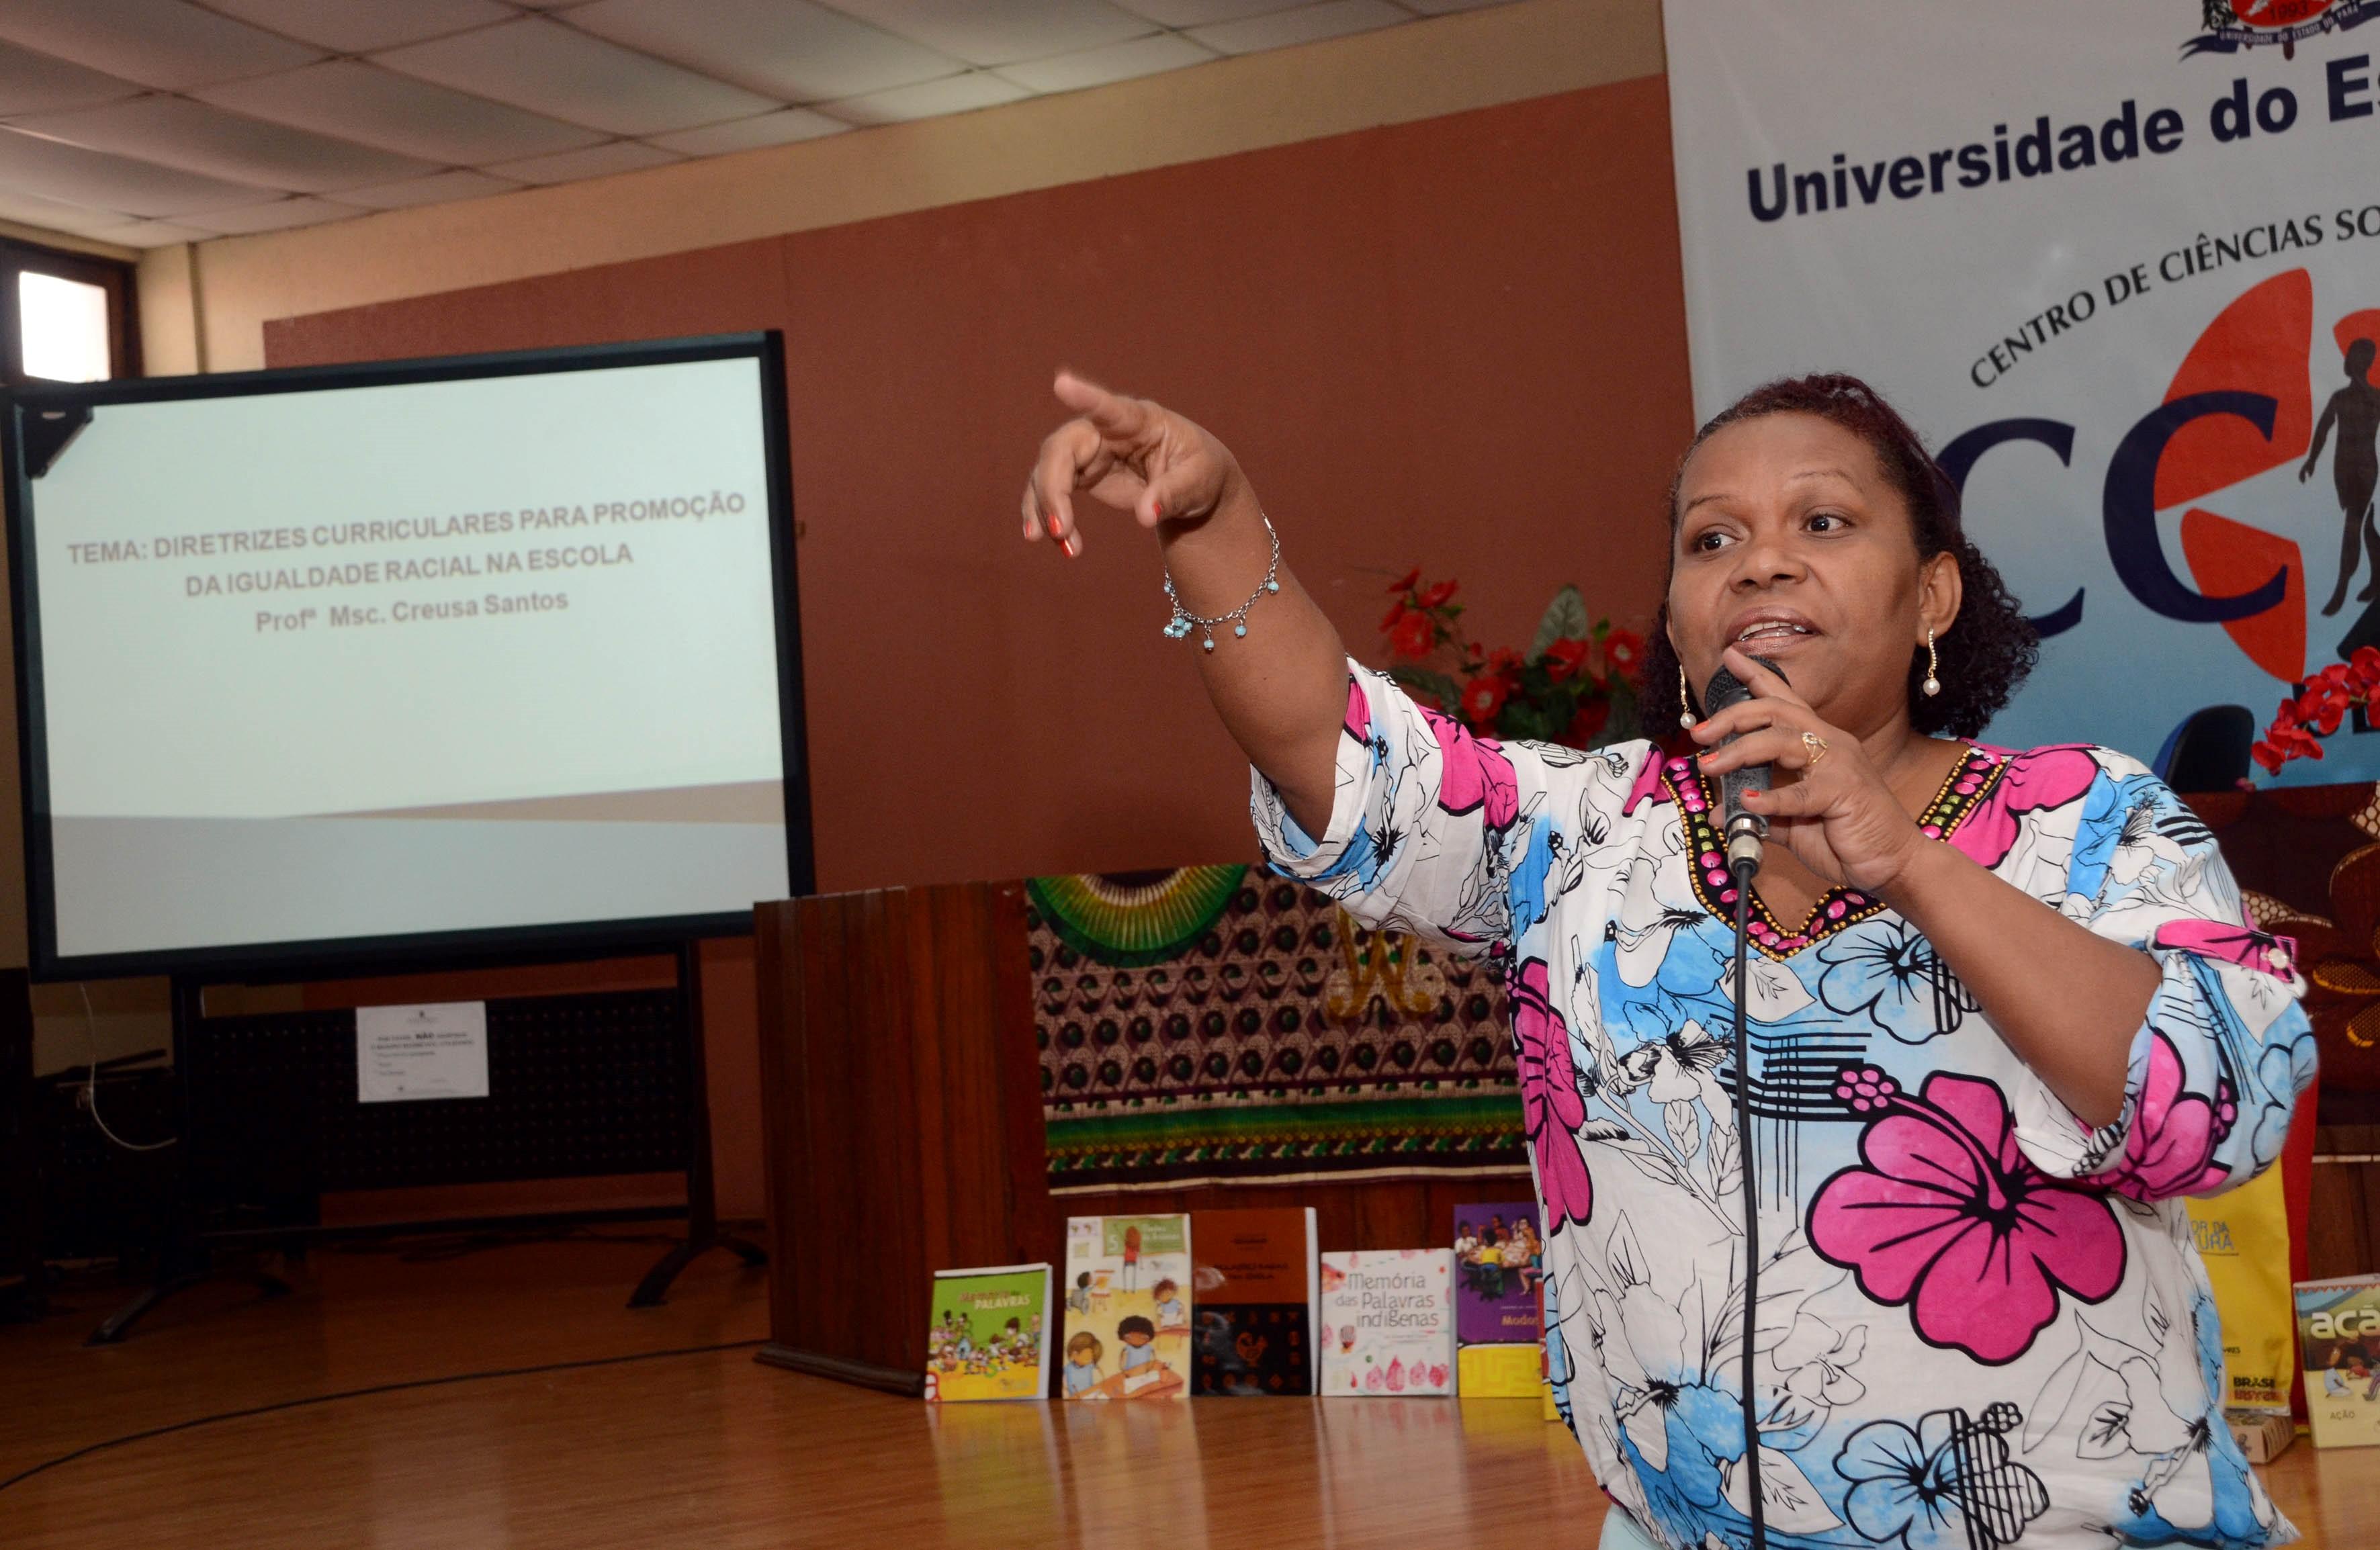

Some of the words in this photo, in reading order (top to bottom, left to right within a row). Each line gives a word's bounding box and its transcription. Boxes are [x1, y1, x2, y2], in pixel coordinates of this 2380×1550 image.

[2269, 1, 2308, 21] 1993
[1746, 99, 2185, 223] Universidade
[2209, 78, 2298, 142] do
[2325, 54, 2380, 123] E
[1970, 289, 2096, 390] CENTRO
[2103, 263, 2151, 306] DE
[2158, 214, 2324, 283] CIÊNCIAS
[2335, 205, 2380, 242] SO
[67, 540, 147, 565] TEMA:
[154, 527, 308, 559] DIRETRIZES
[312, 510, 515, 547] CURRICULARES
[520, 505, 589, 531] PARA
[593, 490, 746, 525] PROMOÇÃO
[186, 575, 224, 598] DA
[227, 561, 380, 594] IGUALDADE
[385, 554, 481, 581] RACIAL
[486, 551, 523, 574] NA
[527, 543, 634, 572] ESCOLA
[329, 603, 386, 628] Msc.
[392, 600, 479, 623] Creusa
[484, 591, 570, 615] Santos
[1348, 1271, 1425, 1290] Memória
[974, 1295, 1031, 1310] PALAVRAS
[1335, 1294, 1358, 1307] das
[1362, 1290, 1436, 1310] Palavras
[2330, 1409, 2356, 1421] AÇÃO
